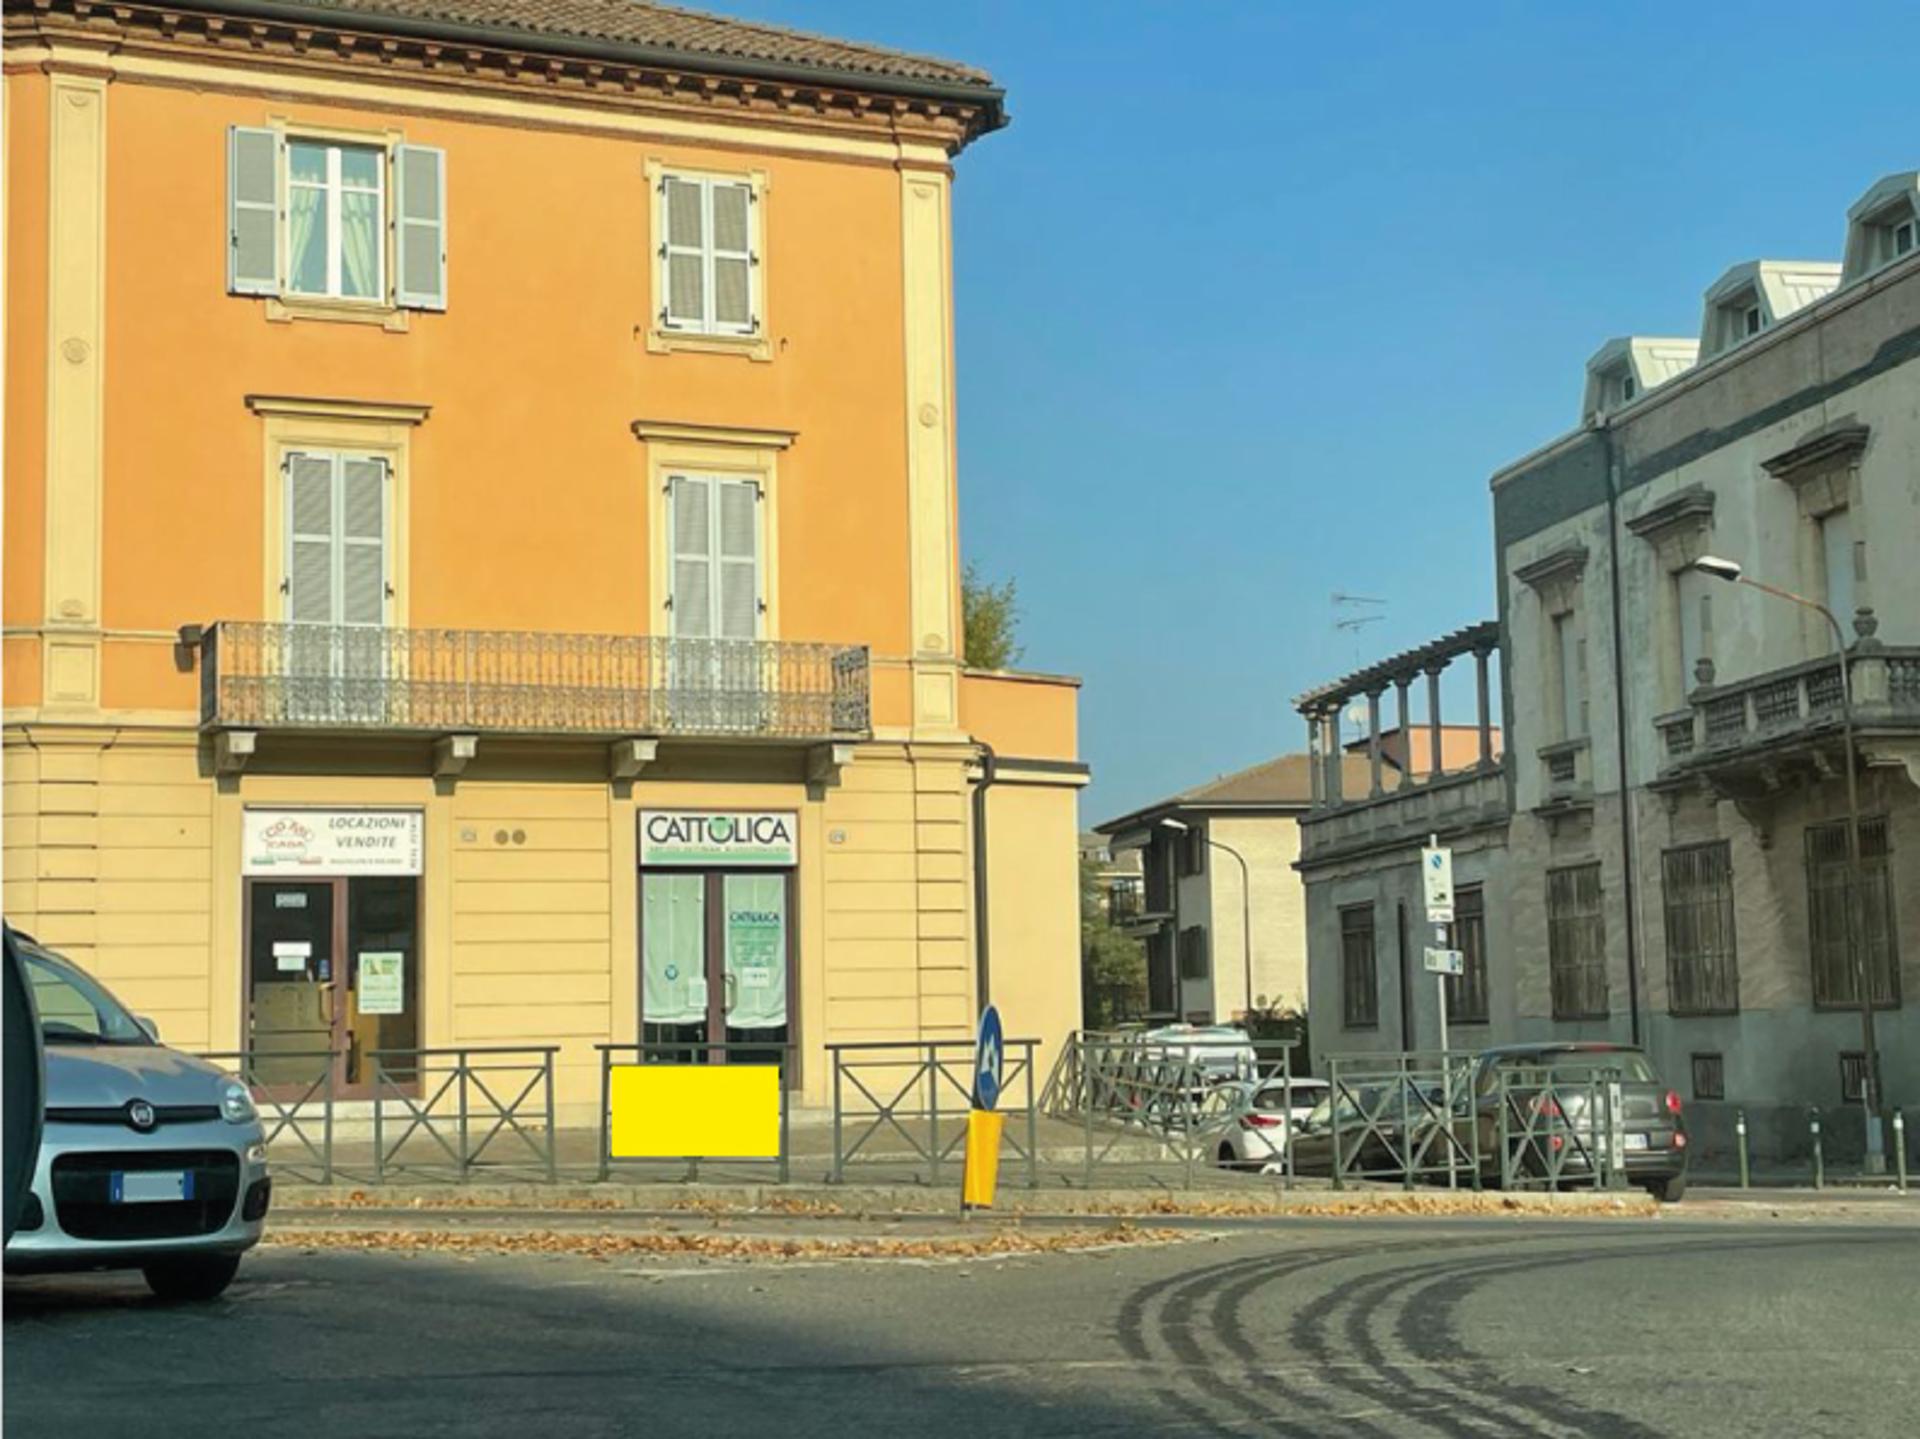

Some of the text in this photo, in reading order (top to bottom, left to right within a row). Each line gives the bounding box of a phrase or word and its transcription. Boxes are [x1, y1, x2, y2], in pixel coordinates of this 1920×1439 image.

[329, 817, 406, 829] LOCAZIONI
[647, 815, 791, 843] CATTOLICA
[336, 836, 396, 848] VENDITE
